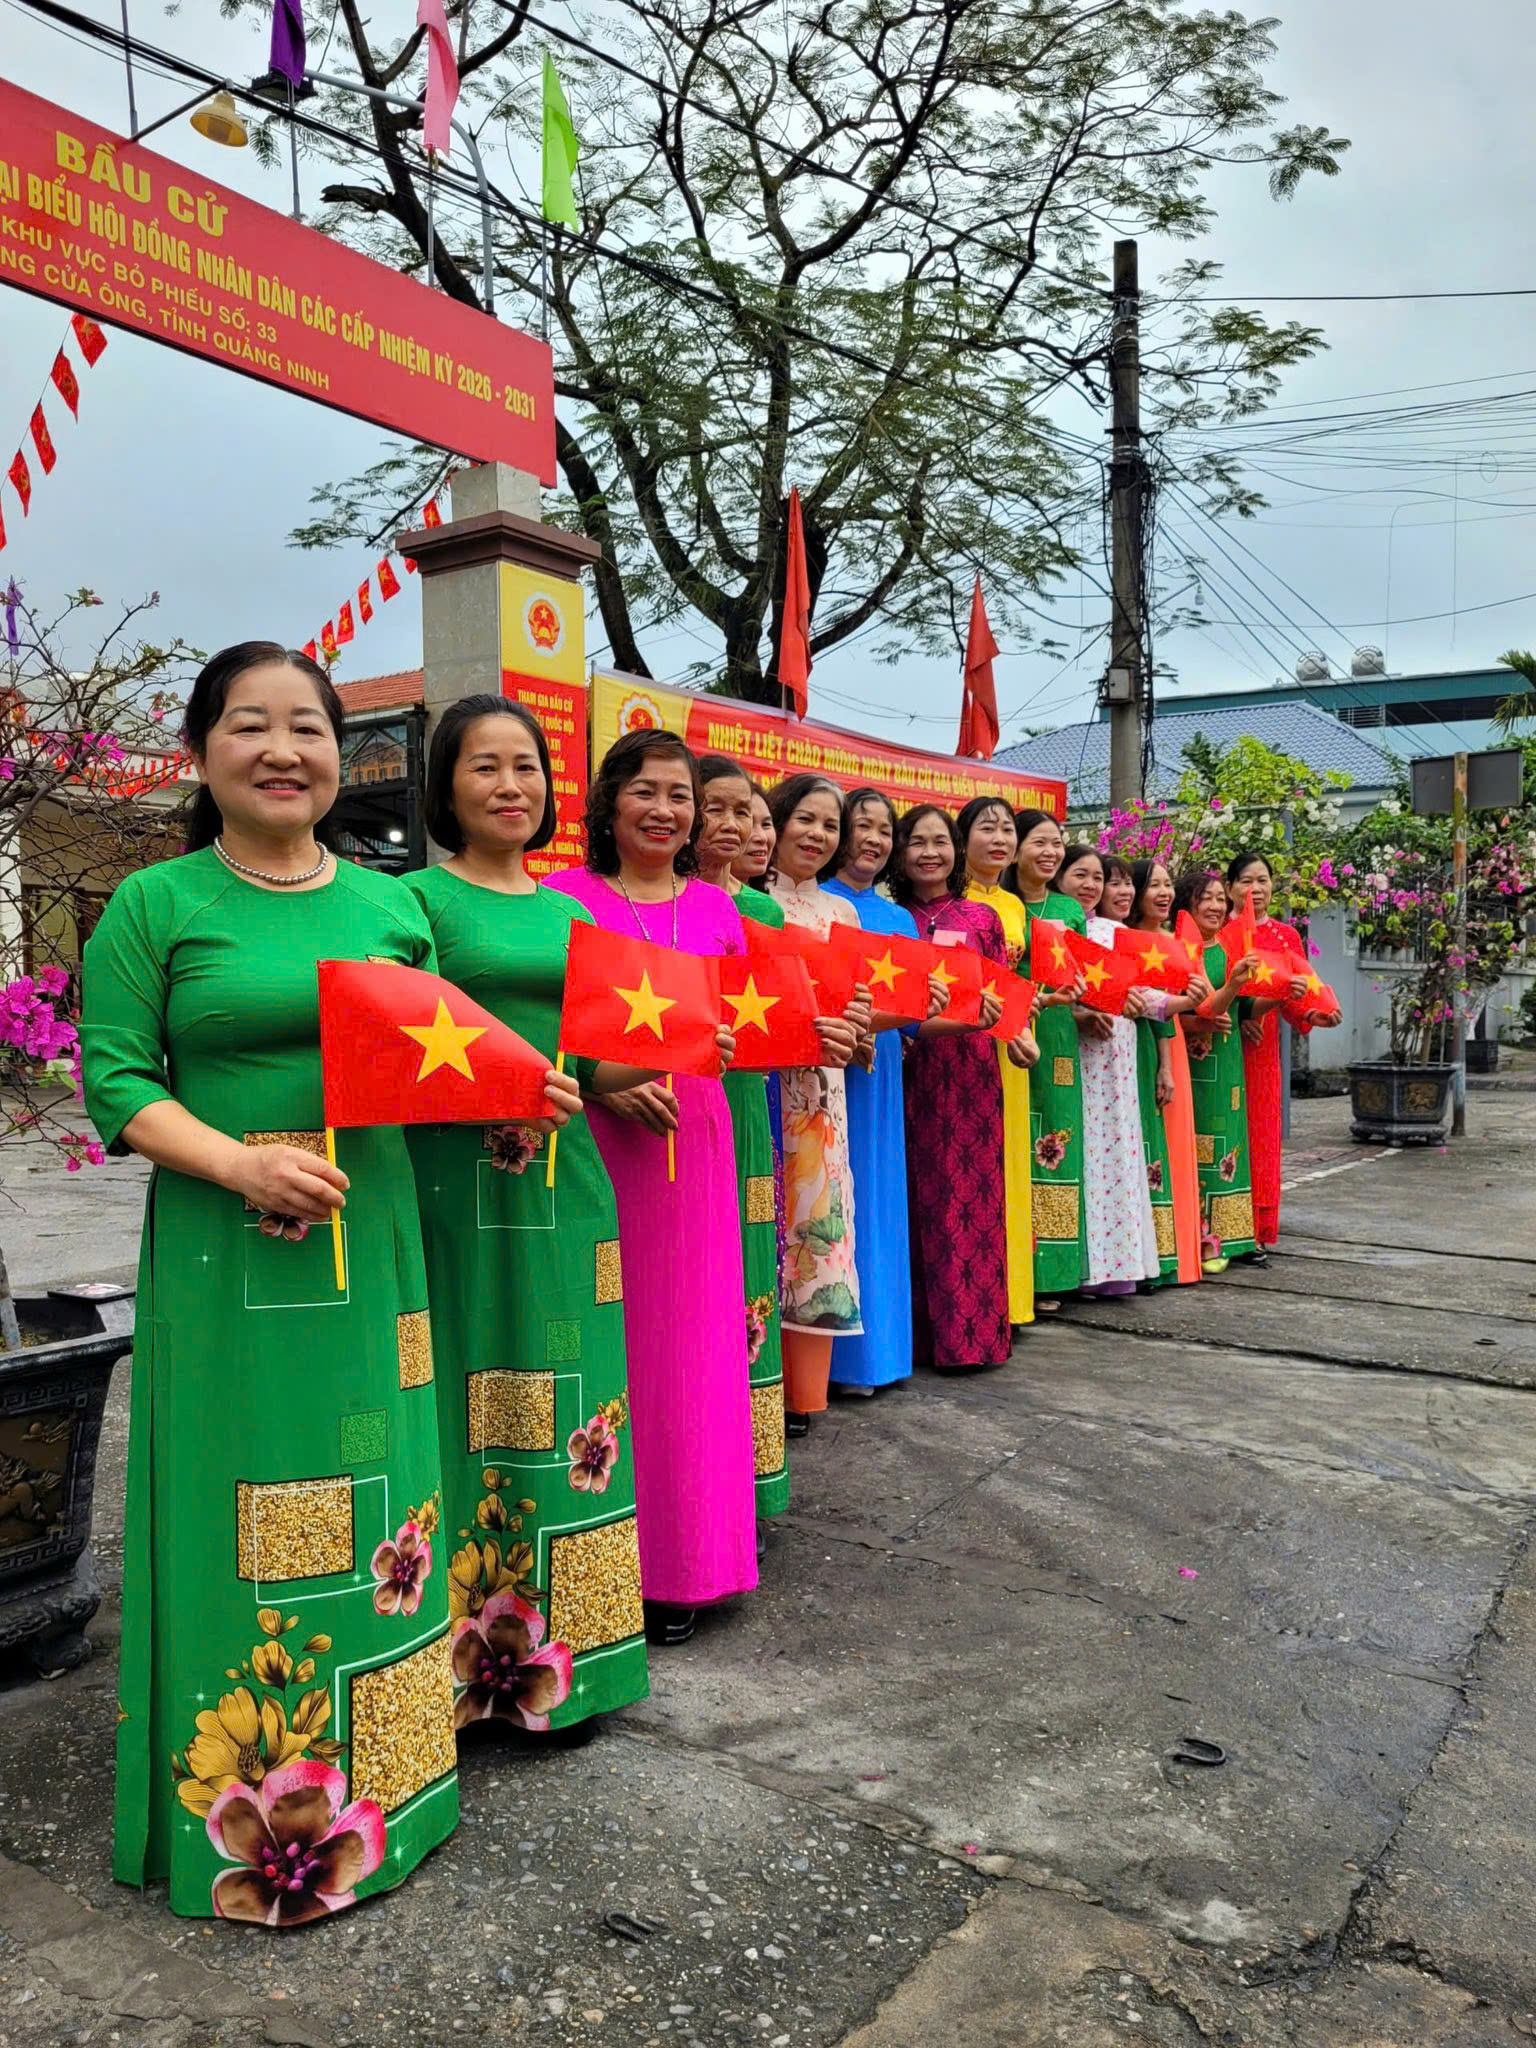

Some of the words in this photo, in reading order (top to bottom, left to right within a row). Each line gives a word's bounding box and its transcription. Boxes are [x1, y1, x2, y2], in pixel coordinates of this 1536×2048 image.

[56, 130, 150, 203] BẦU
[167, 185, 229, 237] CỬ
[2, 216, 52, 251] KHU
[60, 239, 107, 273] VỰC
[114, 261, 145, 288] BỎ
[151, 277, 213, 317] PHIẾU
[218, 304, 250, 333] SỐ:
[257, 321, 277, 343] 33
[27, 172, 82, 227] BIỂU
[88, 199, 127, 251] HỘI
[132, 217, 191, 275] ĐỒNG
[197, 247, 253, 301] NHÂN
[257, 274, 297, 320] DÂN
[301, 294, 337, 336] CÁC
[341, 310, 375, 351] CẤP
[379, 329, 431, 377] NHIỆM
[434, 352, 453, 386] KỲ
[457, 364, 492, 402] 2026
[504, 385, 536, 421] 2031
[44, 264, 92, 298] CỬA
[99, 282, 153, 325] ÔNG,
[158, 308, 207, 343] TỈNH
[213, 331, 281, 371] QUẢNG
[287, 360, 329, 391] NINH
[517, 688, 537, 706] THAM
[537, 693, 549, 708] GIA
[549, 693, 563, 712] BẦU
[550, 737, 560, 751] XVI
[708, 722, 752, 759] NHIỆT
[755, 729, 784, 765] LIỆT
[786, 738, 820, 769] CHÀO
[824, 746, 860, 776] MỪNG
[862, 755, 891, 783] NGÀY
[894, 758, 915, 787] BẦU
[918, 762, 932, 790] CỬ
